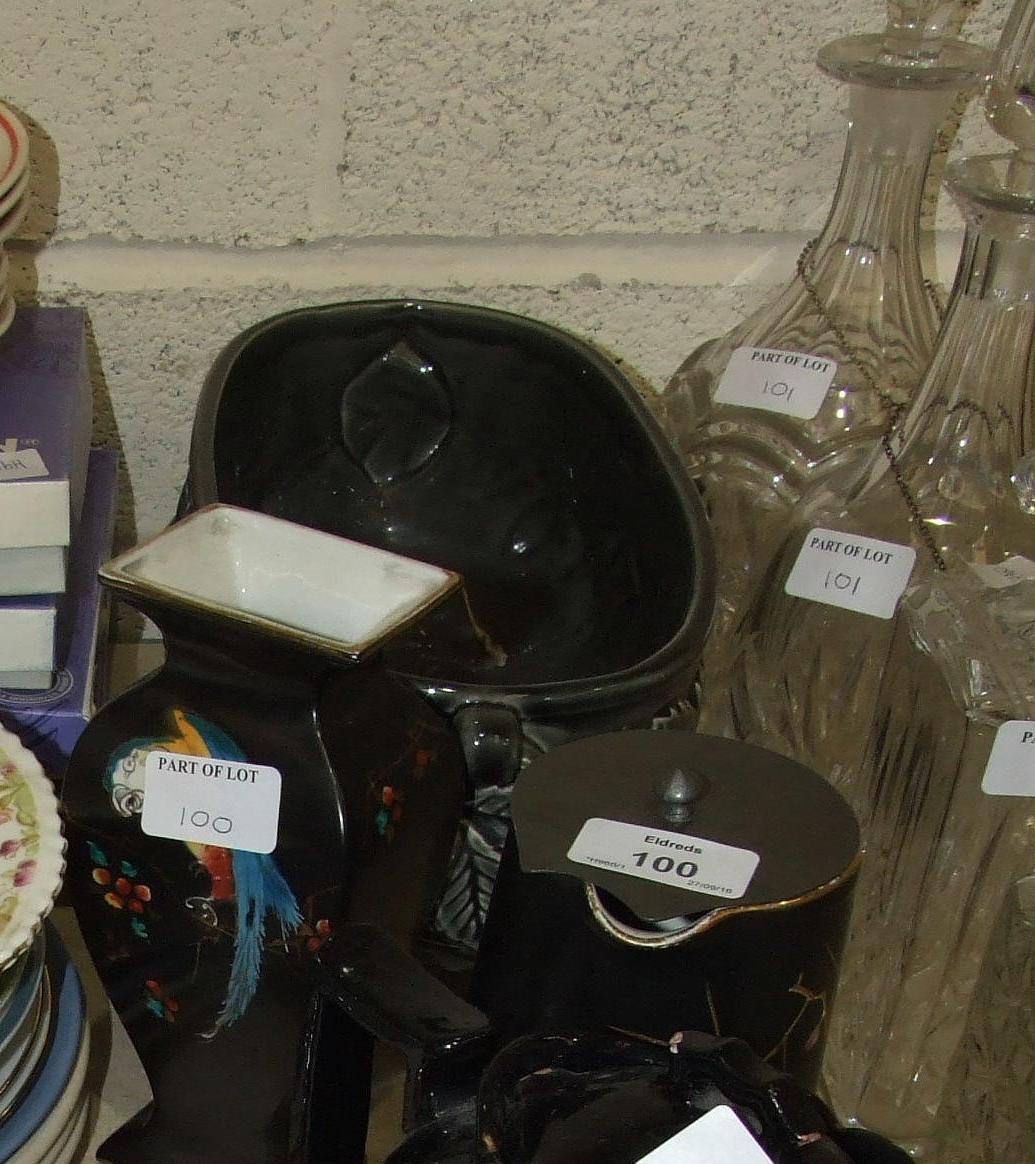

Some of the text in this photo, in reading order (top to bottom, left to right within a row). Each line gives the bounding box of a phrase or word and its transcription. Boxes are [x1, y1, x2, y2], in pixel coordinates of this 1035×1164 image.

[751, 351, 832, 373] PART OF LOT
[763, 380, 794, 402] 101
[809, 537, 894, 565] PART OF LOT
[824, 569, 861, 595] 101
[158, 756, 259, 784] PART OF LOT
[180, 807, 233, 834] 100
[643, 834, 703, 855] Eldreds
[632, 851, 699, 879] 100
